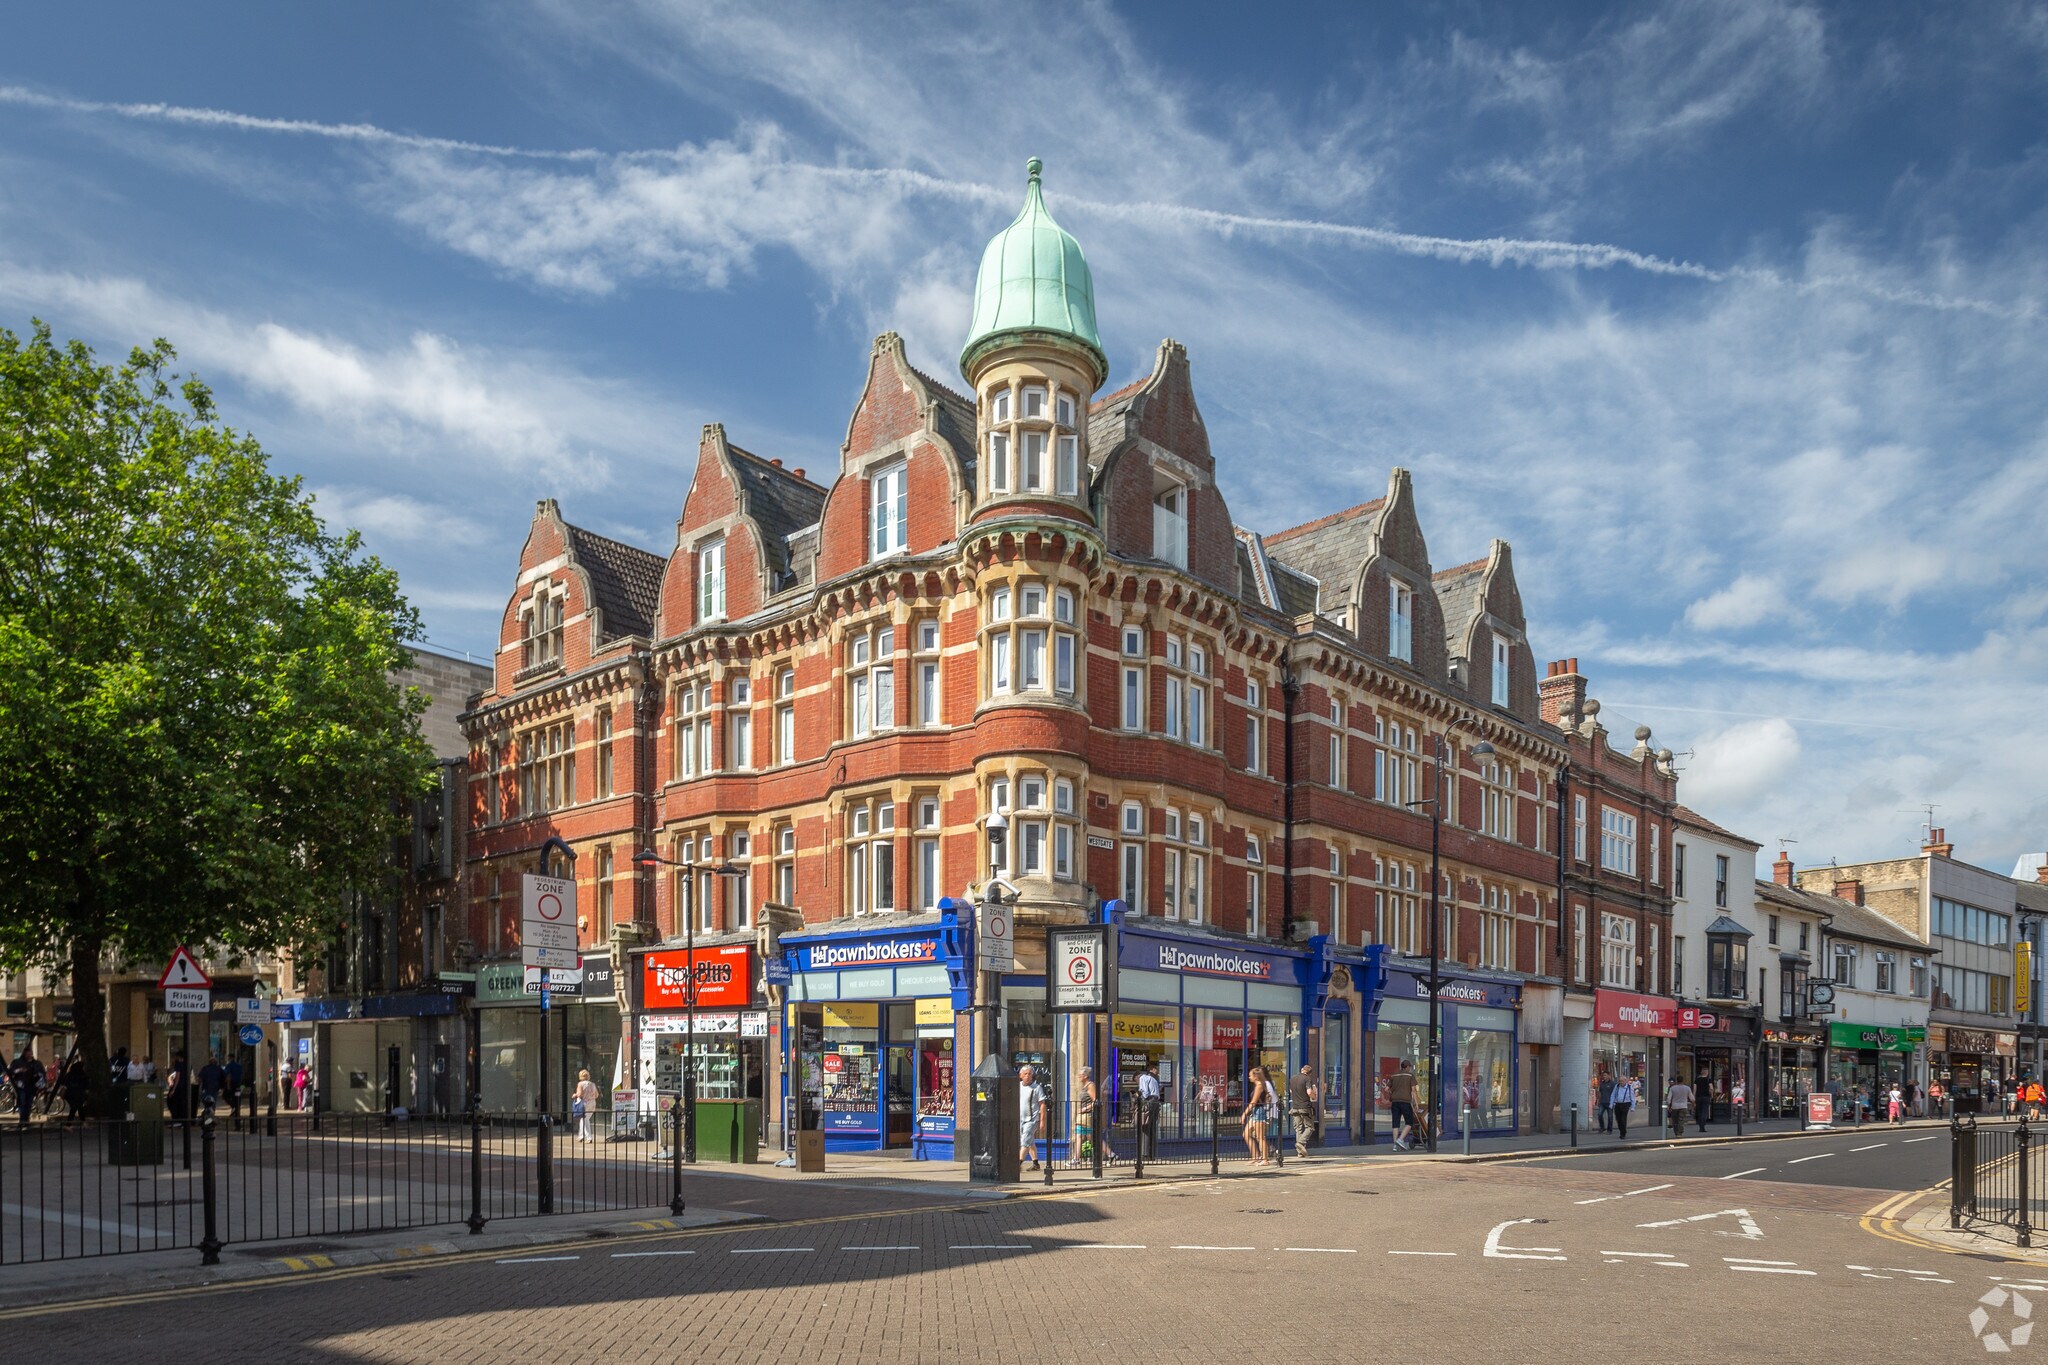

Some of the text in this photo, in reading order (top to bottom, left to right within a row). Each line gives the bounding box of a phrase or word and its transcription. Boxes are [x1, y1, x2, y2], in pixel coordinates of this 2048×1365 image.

[1088, 837, 1112, 849] WESTGATE
[536, 882, 564, 895] ZONE
[989, 909, 1006, 917] ZONE
[1068, 946, 1092, 954] ZONE
[696, 960, 732, 984] Plus
[769, 965, 790, 973] CHEQUE
[769, 972, 791, 980] CASHING
[901, 976, 924, 985] CHEQUE
[859, 980, 869, 988] BUY
[870, 979, 885, 987] GOLD
[172, 991, 203, 1000] Rising
[170, 1000, 206, 1009] Bollard
[212, 1000, 236, 1011] pharmacy
[1619, 1004, 1659, 1027] amplifon
[1862, 1032, 1877, 1042] CASH
[1883, 1034, 1897, 1043] SHOP
[1121, 1052, 1147, 1061] free cash
[1202, 1074, 1225, 1087] SALE
